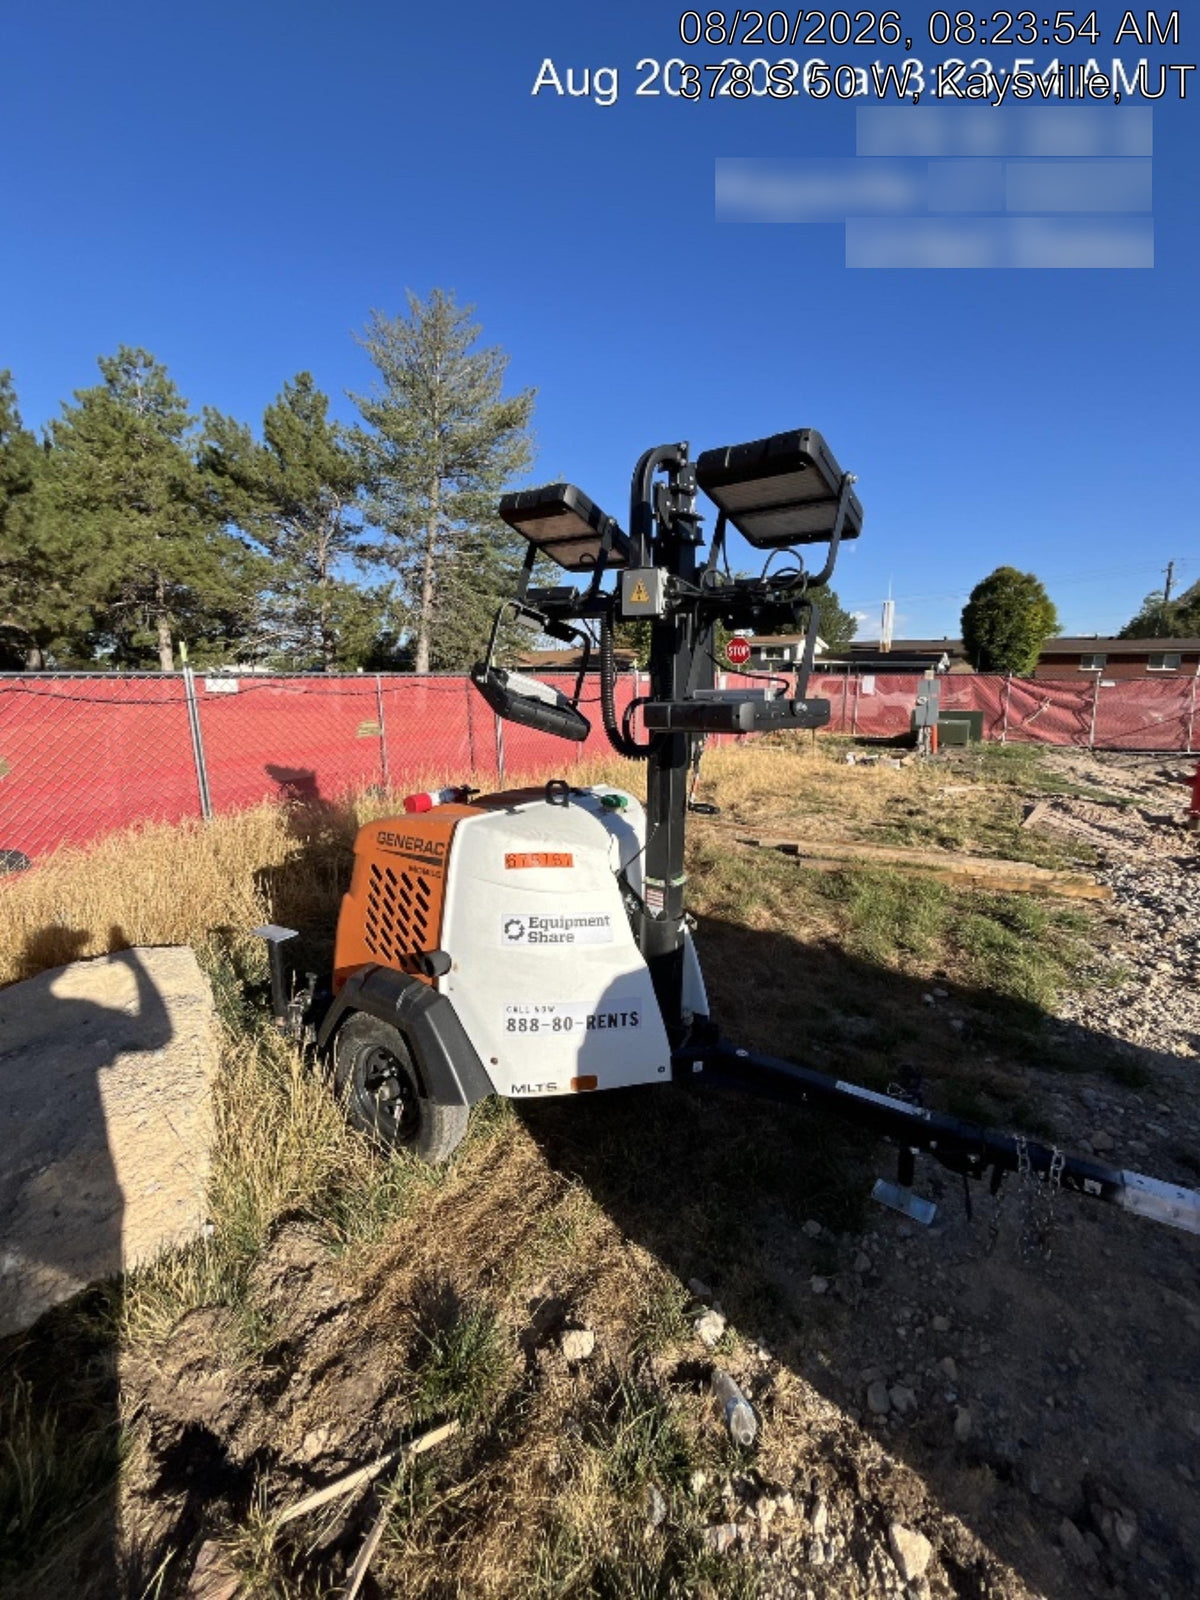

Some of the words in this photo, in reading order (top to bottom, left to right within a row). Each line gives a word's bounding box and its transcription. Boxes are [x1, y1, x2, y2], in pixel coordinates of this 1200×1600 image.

[728, 645, 749, 657] STOP
[376, 831, 445, 856] GENERAC
[528, 914, 611, 932] Equipment
[527, 931, 575, 943] Share
[506, 1011, 639, 1032] 888-80-RENTS
